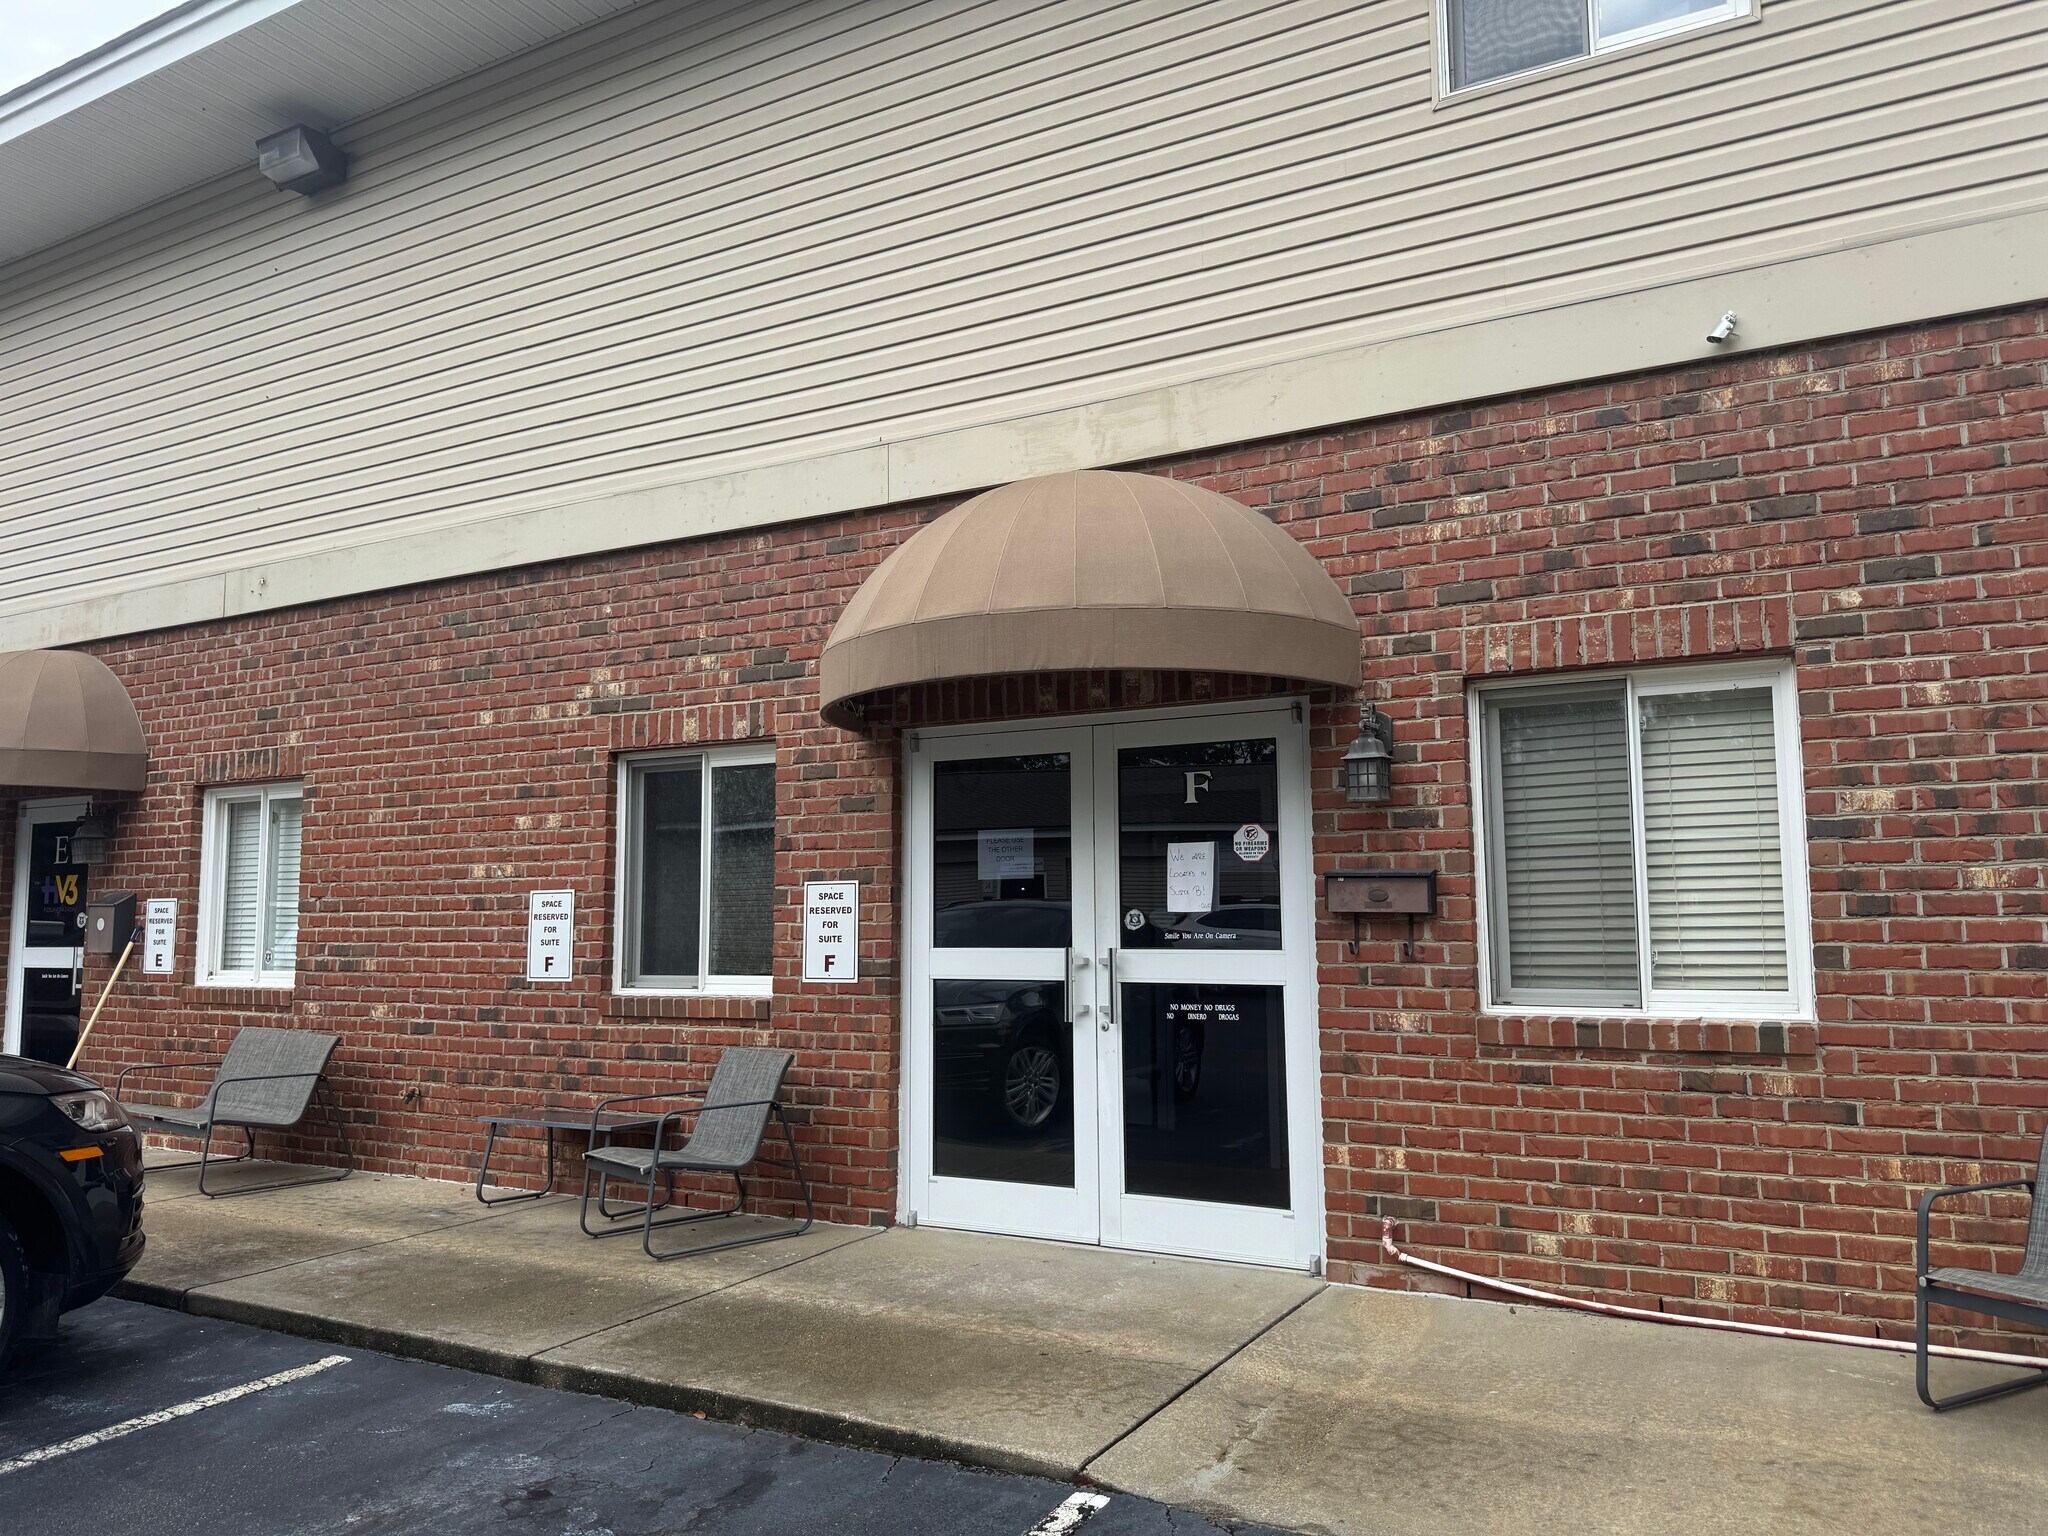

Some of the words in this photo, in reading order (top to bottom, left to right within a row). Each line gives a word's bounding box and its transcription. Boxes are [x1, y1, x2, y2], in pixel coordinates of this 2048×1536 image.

[1184, 771, 1213, 804] F
[53, 836, 69, 865] E
[818, 892, 844, 900] SPACE
[1193, 885, 1205, 896] B!
[819, 935, 842, 943] SUITE
[156, 954, 162, 967] E
[545, 957, 554, 972] F
[825, 955, 835, 972] F
